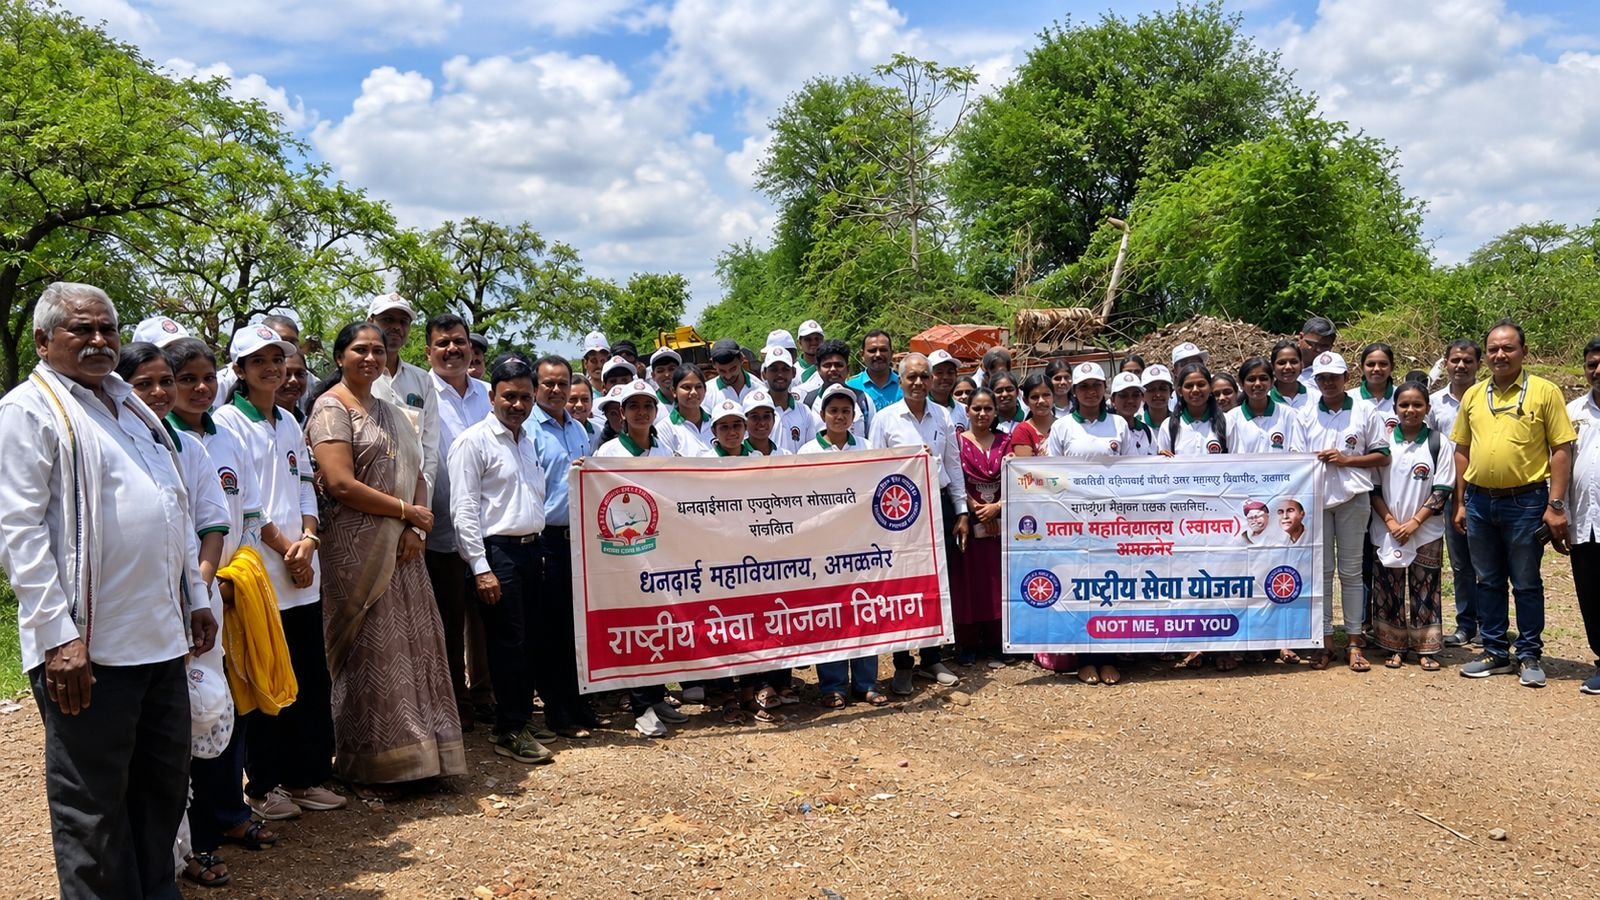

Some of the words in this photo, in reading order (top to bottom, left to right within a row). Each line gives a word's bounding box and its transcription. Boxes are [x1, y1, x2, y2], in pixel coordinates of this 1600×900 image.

[1046, 521, 1083, 537] प्रताप
[1088, 516, 1173, 538] महाविद्यालय
[1179, 515, 1242, 537] (स्वायत्त)
[640, 560, 702, 597] धनदाई
[709, 555, 816, 589] महाविद्यालय,
[1072, 570, 1137, 607] राष्ट्रीय
[1141, 570, 1183, 600] सेवा
[1188, 569, 1255, 599] योजना
[607, 610, 695, 662] राष्ट्रीय
[704, 605, 754, 645] सेवा
[763, 597, 842, 636] योजना
[850, 587, 925, 626] विभाग
[1095, 620, 1128, 633] NOT
[1132, 619, 1159, 635] ME,
[1164, 619, 1196, 632] BUT
[1199, 618, 1232, 631] YOU
